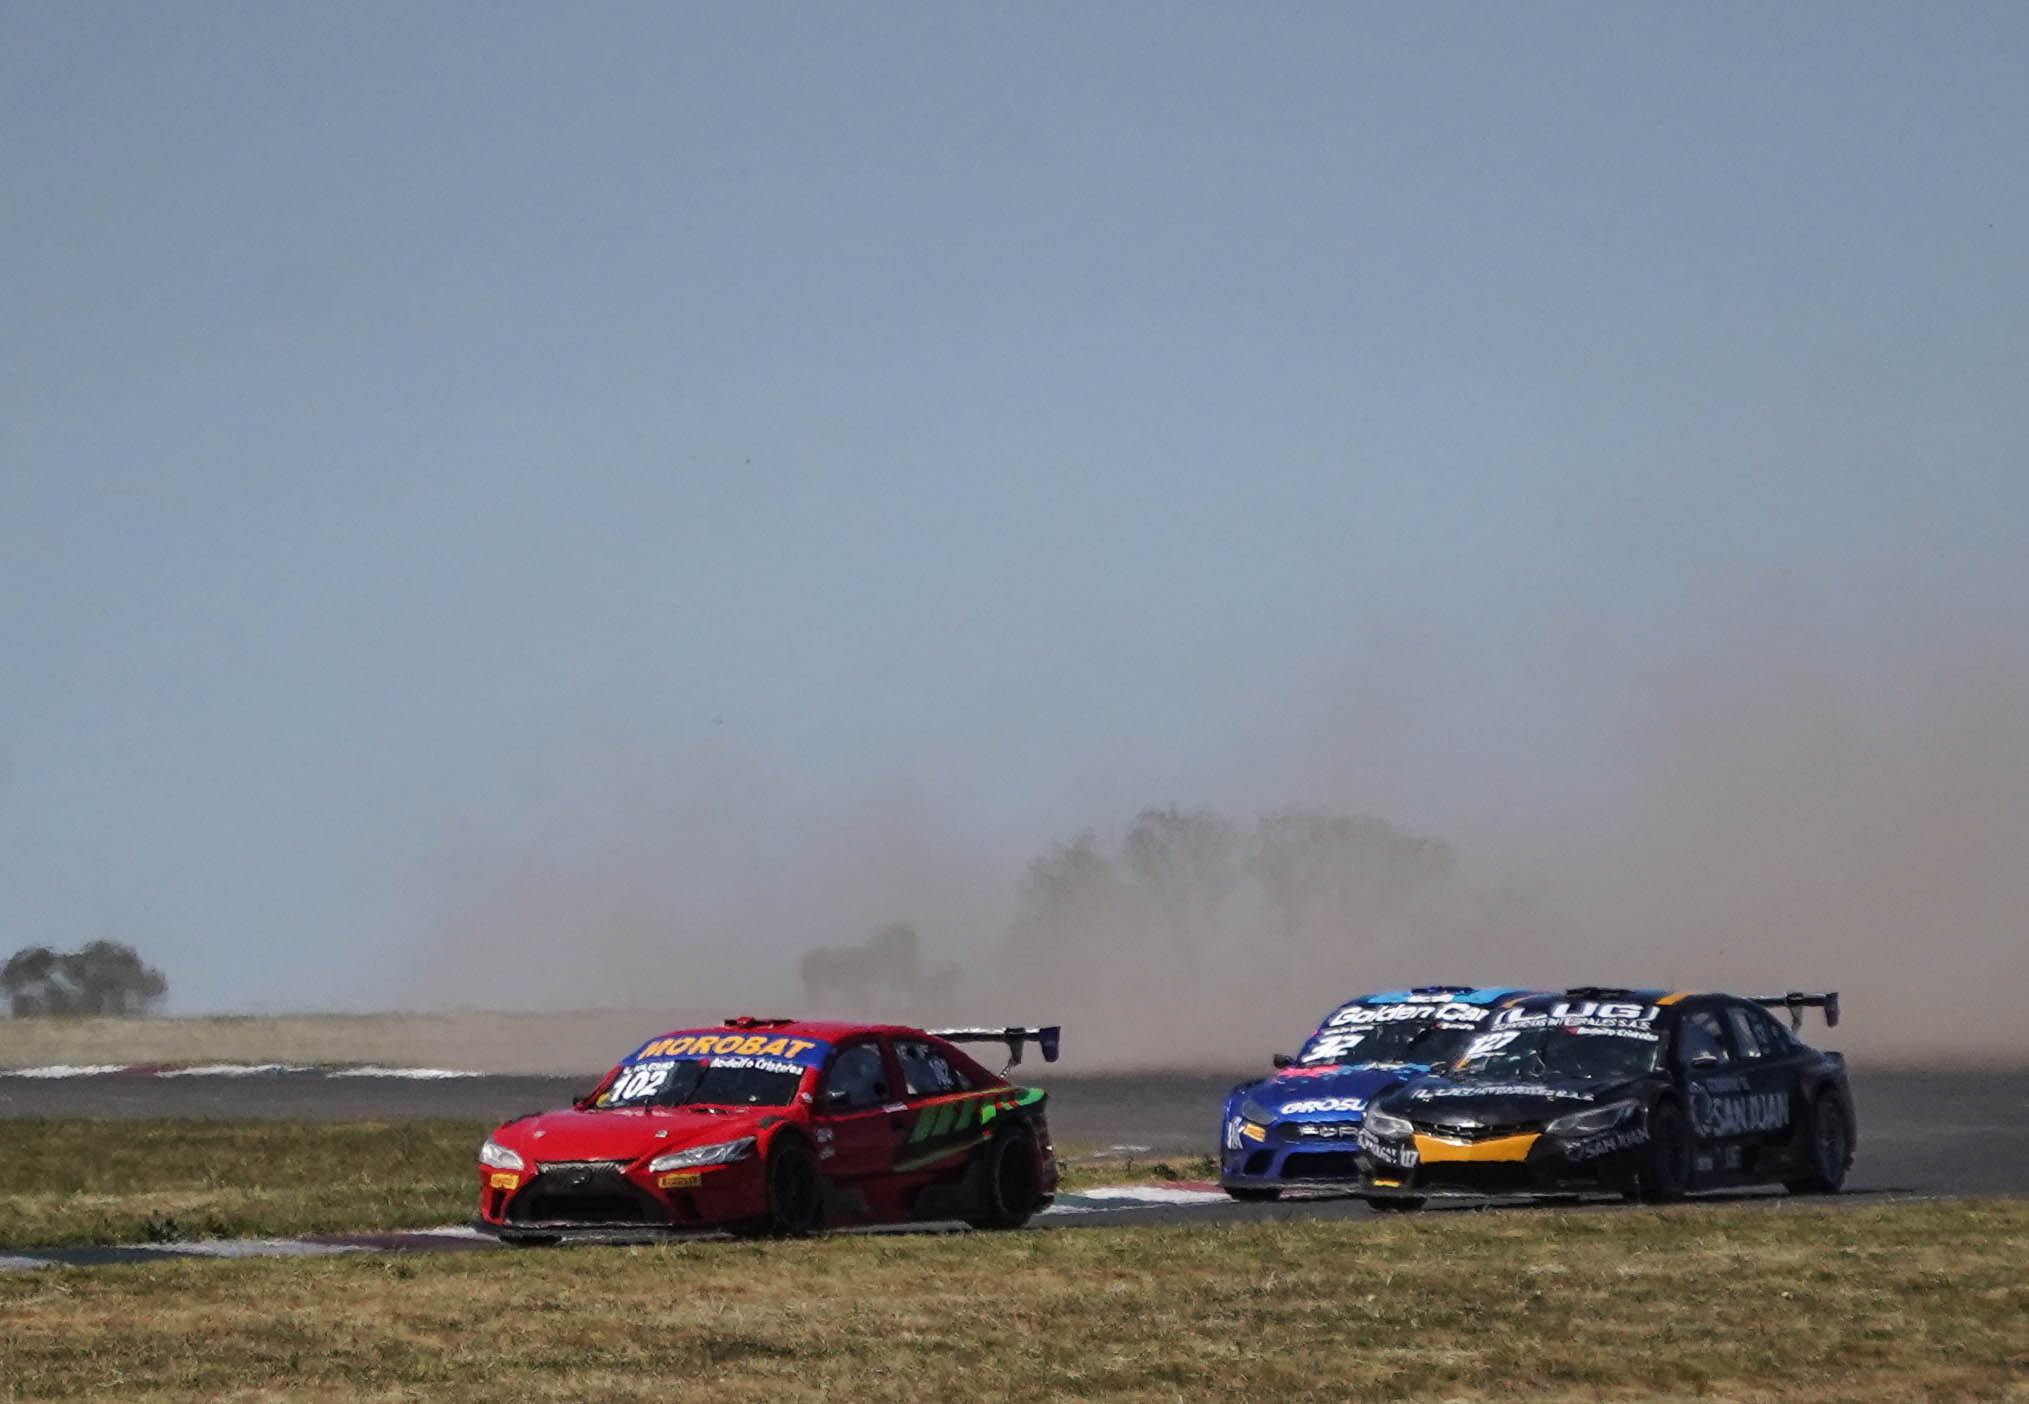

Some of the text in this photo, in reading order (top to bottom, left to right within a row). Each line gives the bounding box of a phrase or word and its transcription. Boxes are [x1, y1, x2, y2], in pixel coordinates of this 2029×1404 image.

[1329, 1004, 1435, 1026] Golden
[638, 1036, 815, 1060] MOROBAT
[610, 1071, 667, 1102] 102
[1298, 1125, 1359, 1138] FOR
